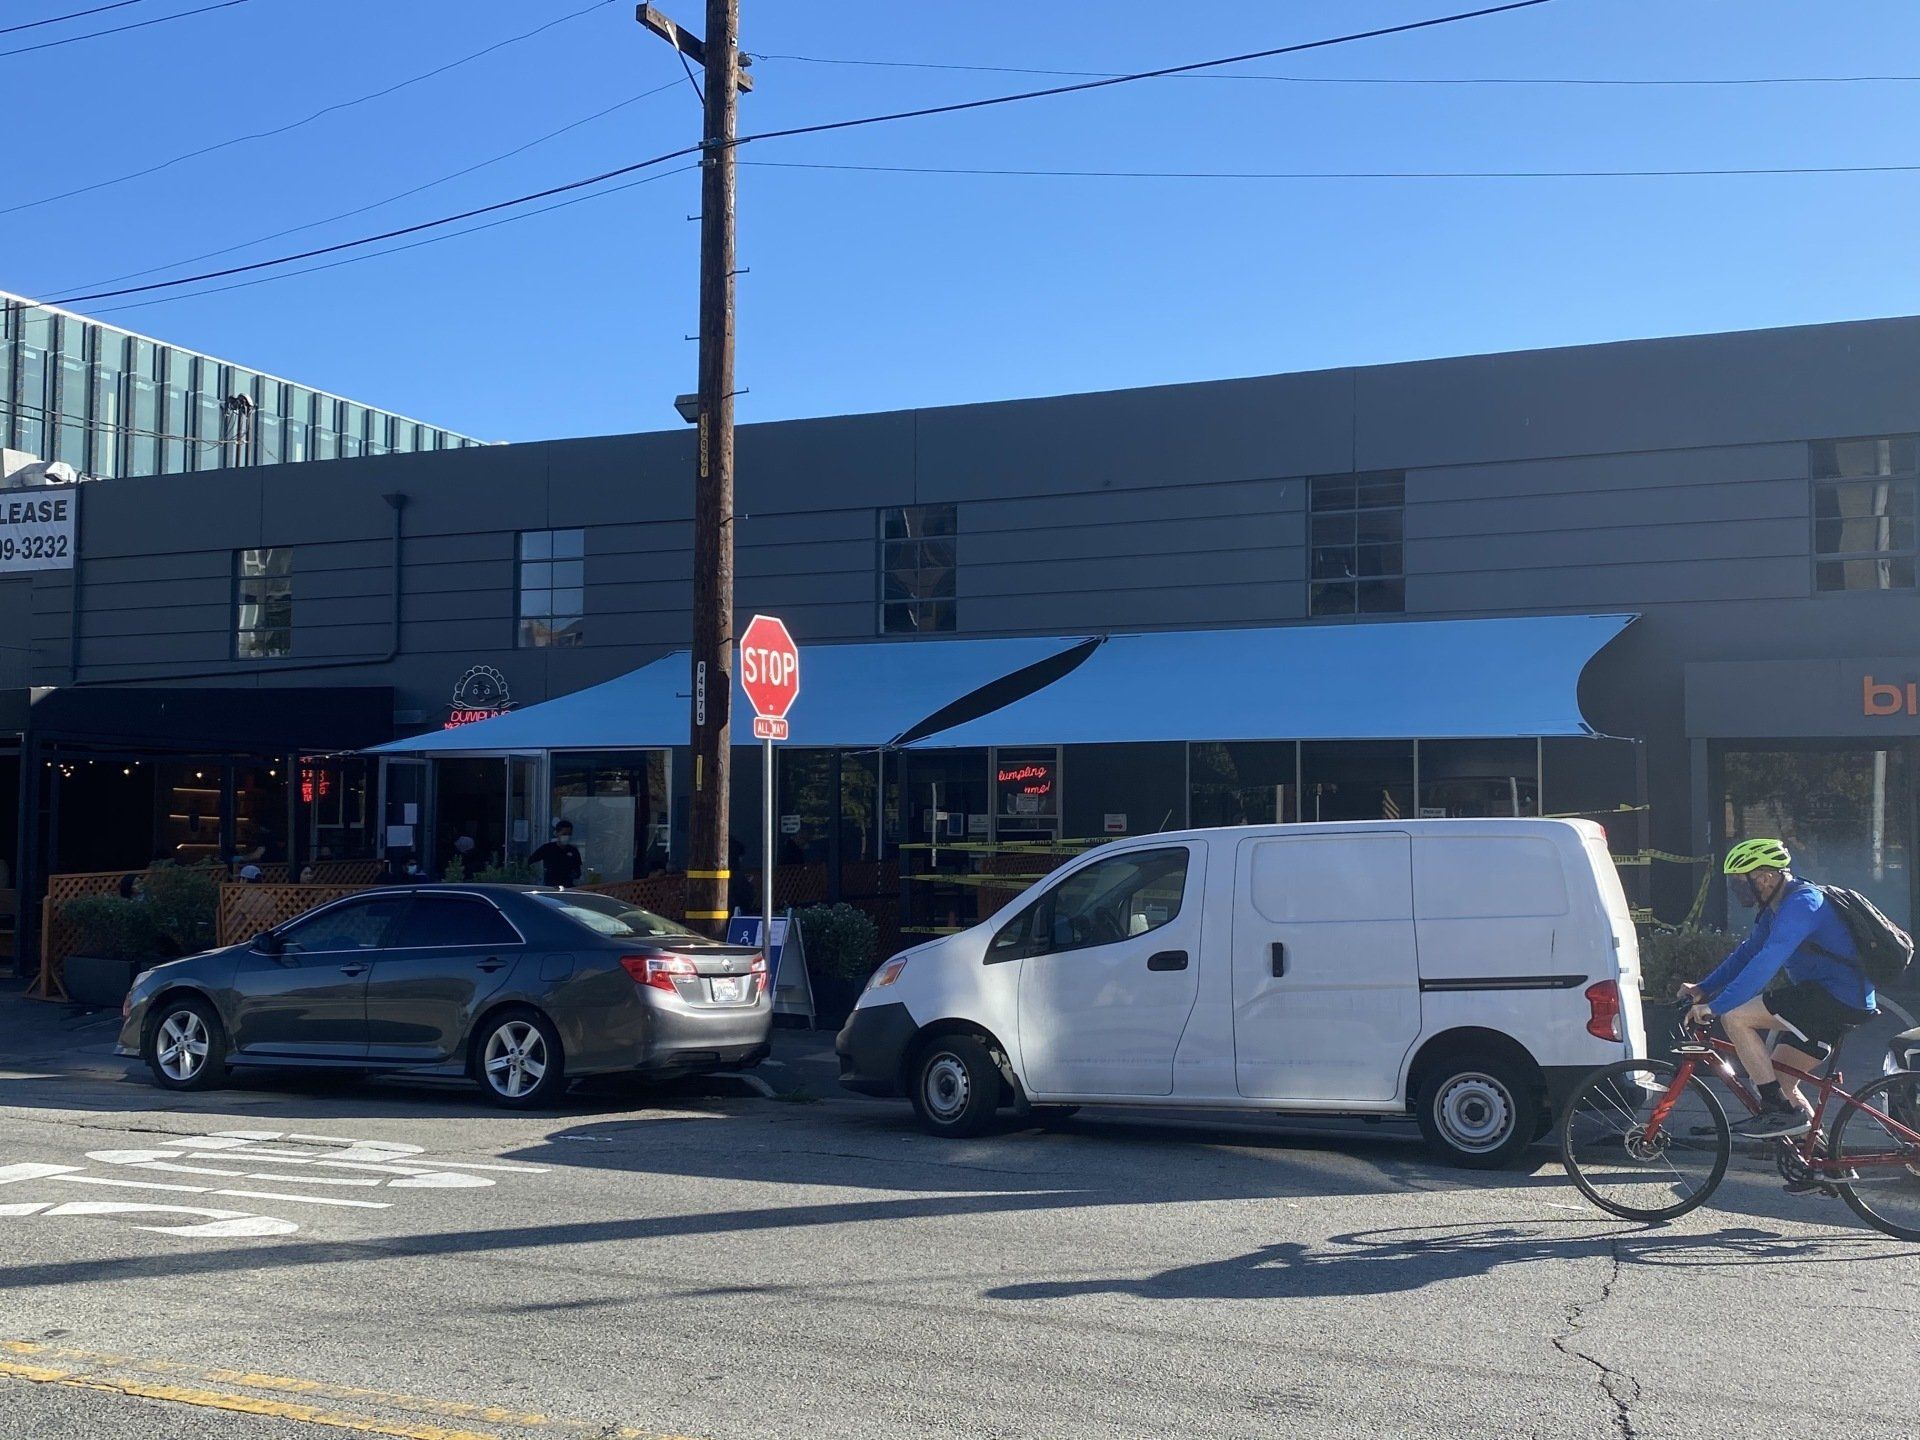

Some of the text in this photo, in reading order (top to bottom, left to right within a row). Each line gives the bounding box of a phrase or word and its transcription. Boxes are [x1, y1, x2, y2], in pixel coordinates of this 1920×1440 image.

[0, 500, 67, 524] LEASE
[0, 535, 67, 560] 9-3232
[745, 646, 795, 687] STOP
[757, 721, 785, 735] ALL WAY
